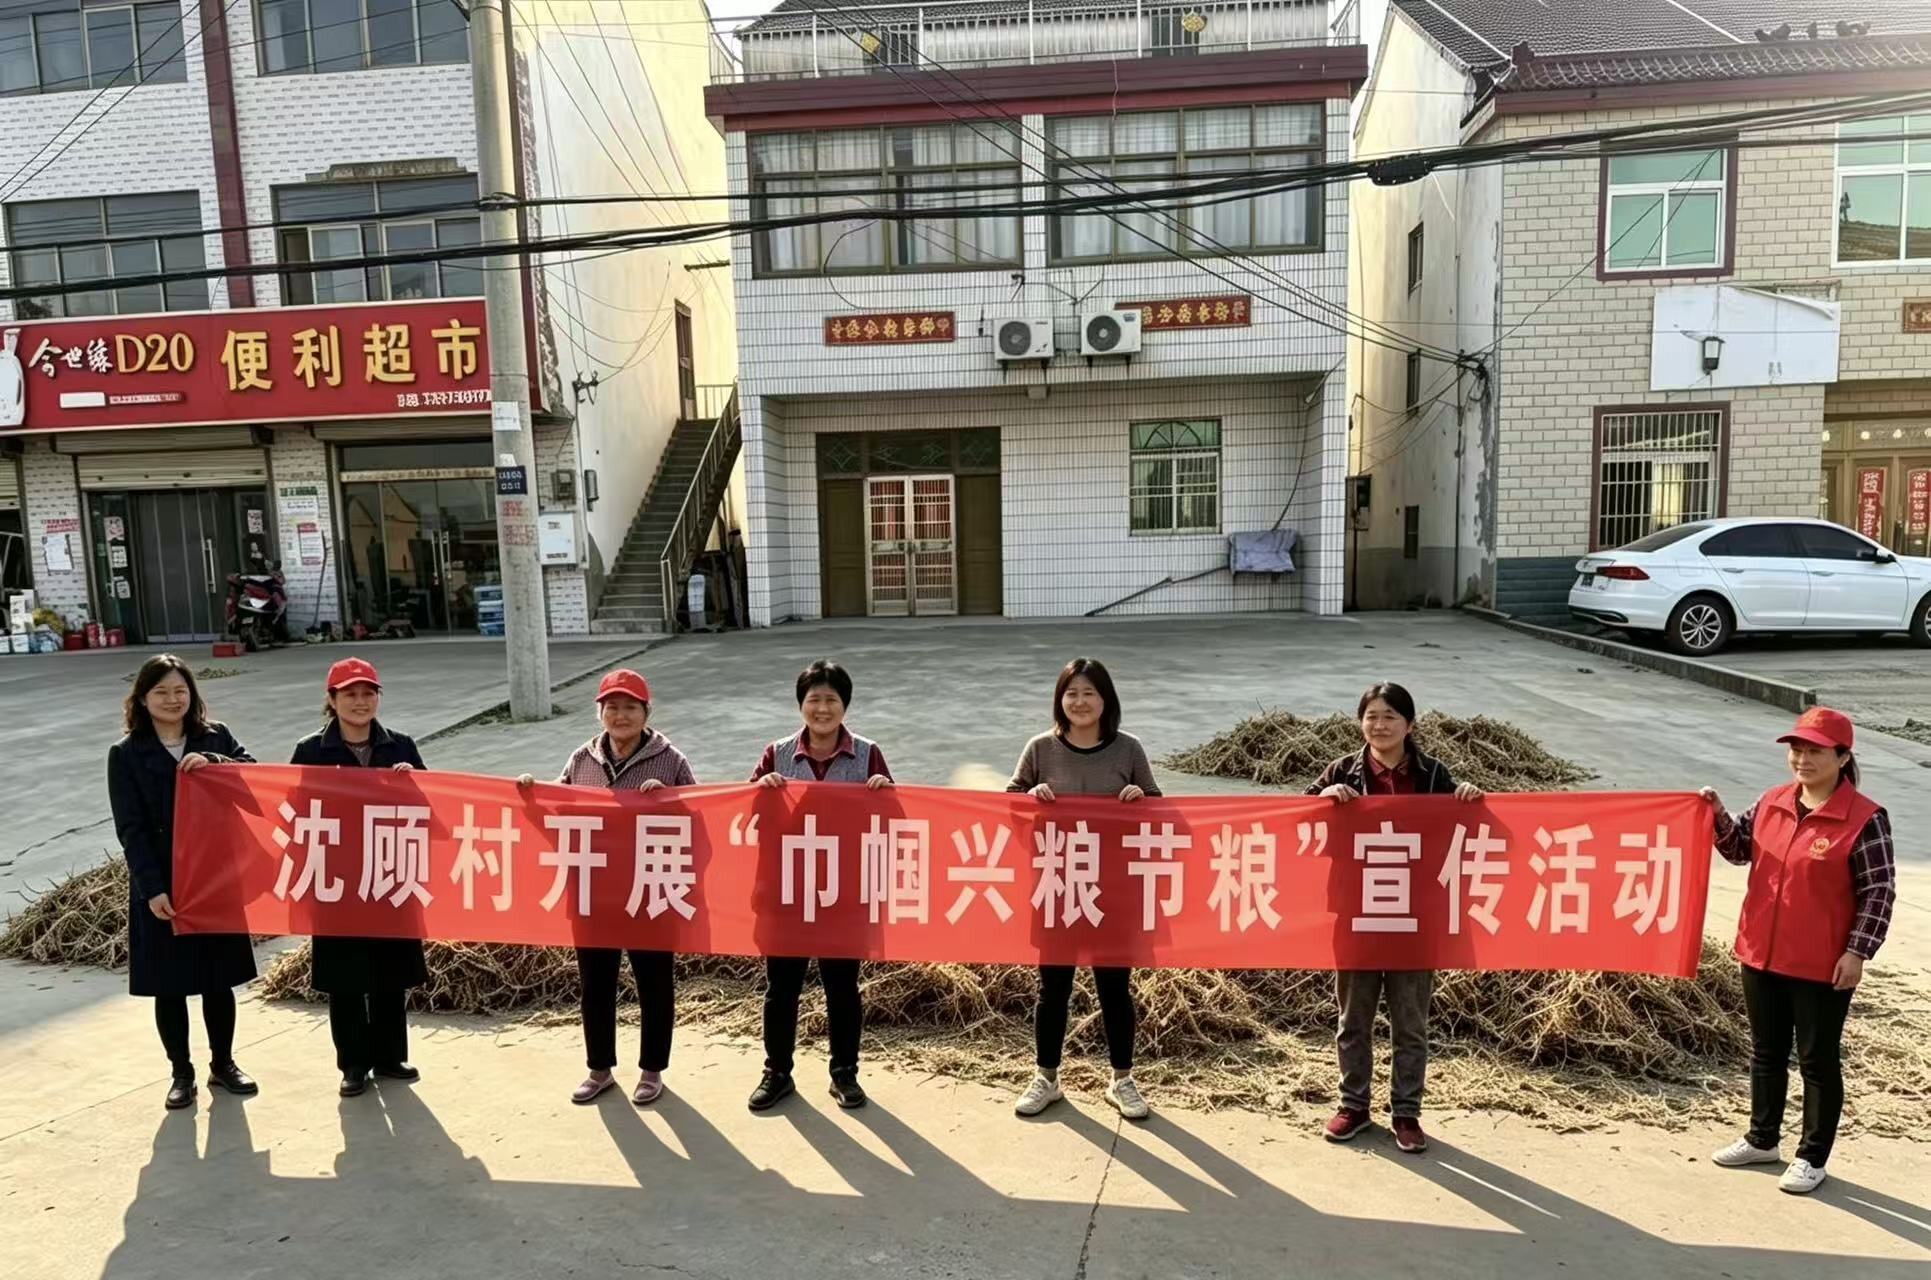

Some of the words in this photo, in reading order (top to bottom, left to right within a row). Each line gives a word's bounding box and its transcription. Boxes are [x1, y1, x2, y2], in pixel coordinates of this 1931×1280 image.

[115, 333, 194, 373] D20
[220, 319, 481, 391] 便利超市
